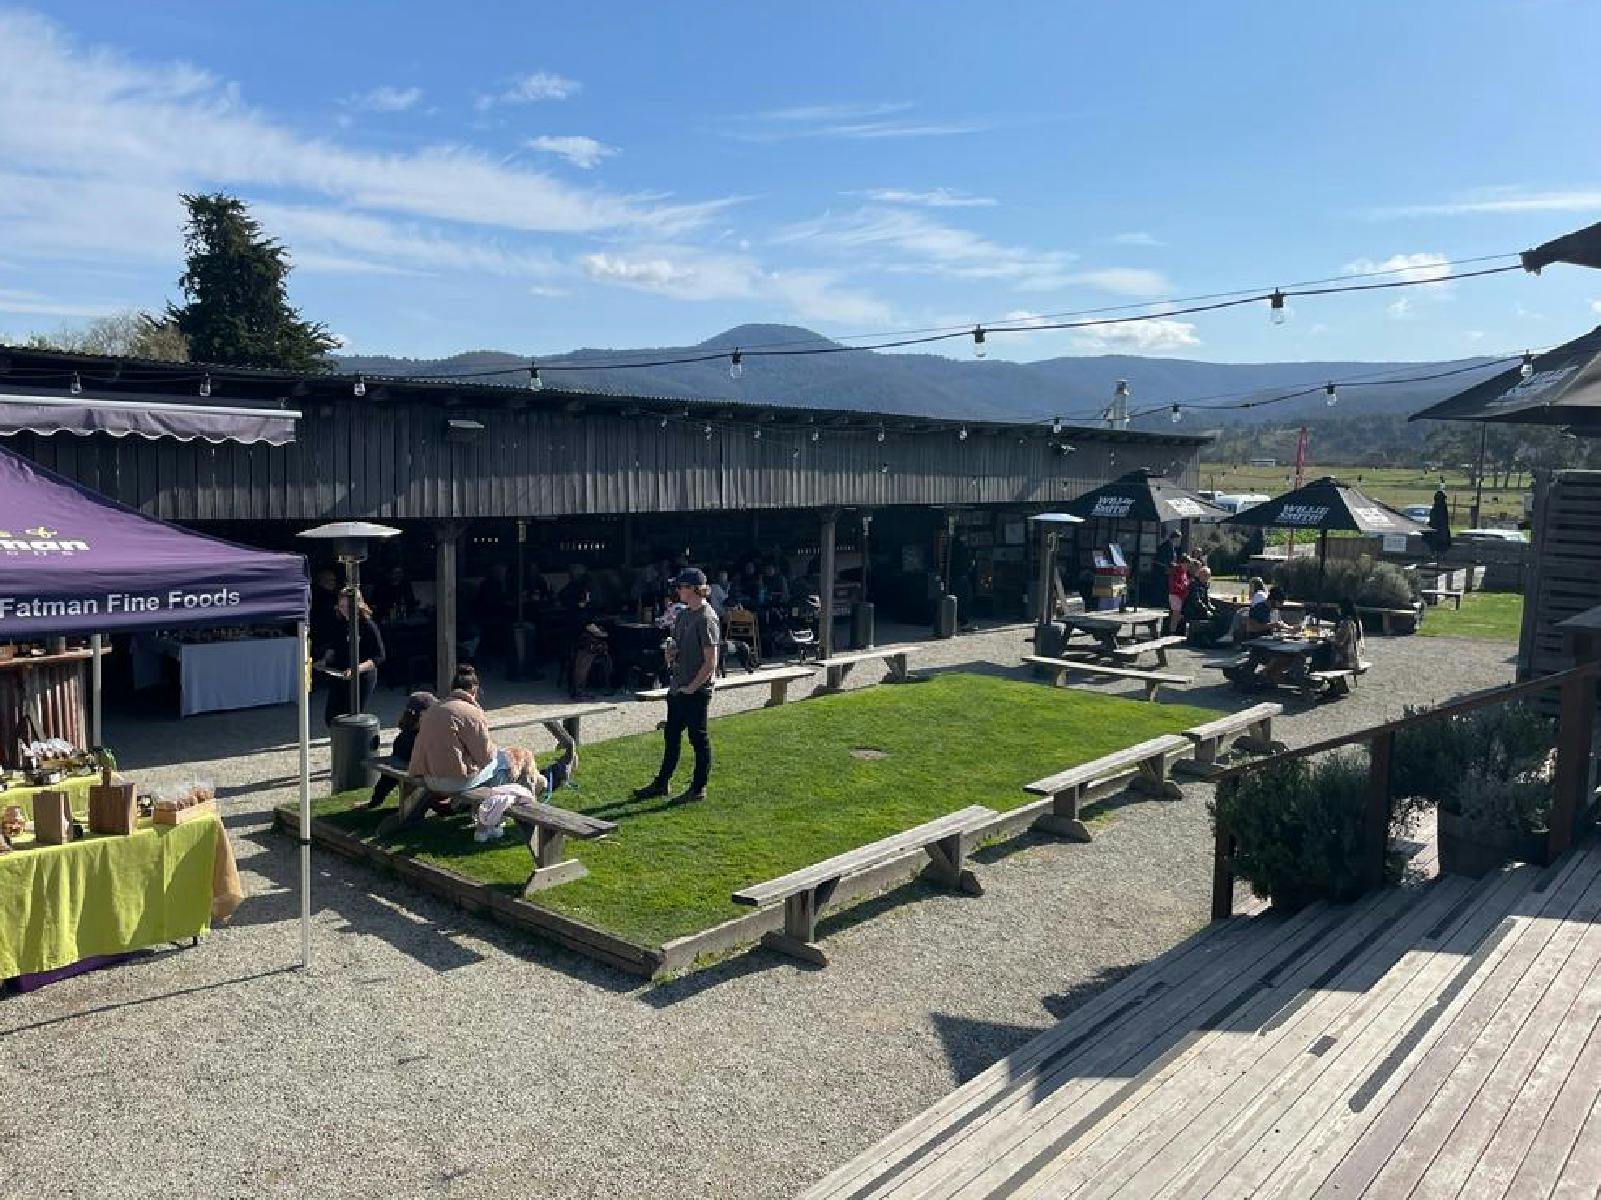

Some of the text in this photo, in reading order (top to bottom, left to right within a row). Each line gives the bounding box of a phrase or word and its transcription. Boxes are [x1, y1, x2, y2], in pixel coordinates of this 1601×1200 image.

[0, 588, 241, 620] Fatman Fine Foods
